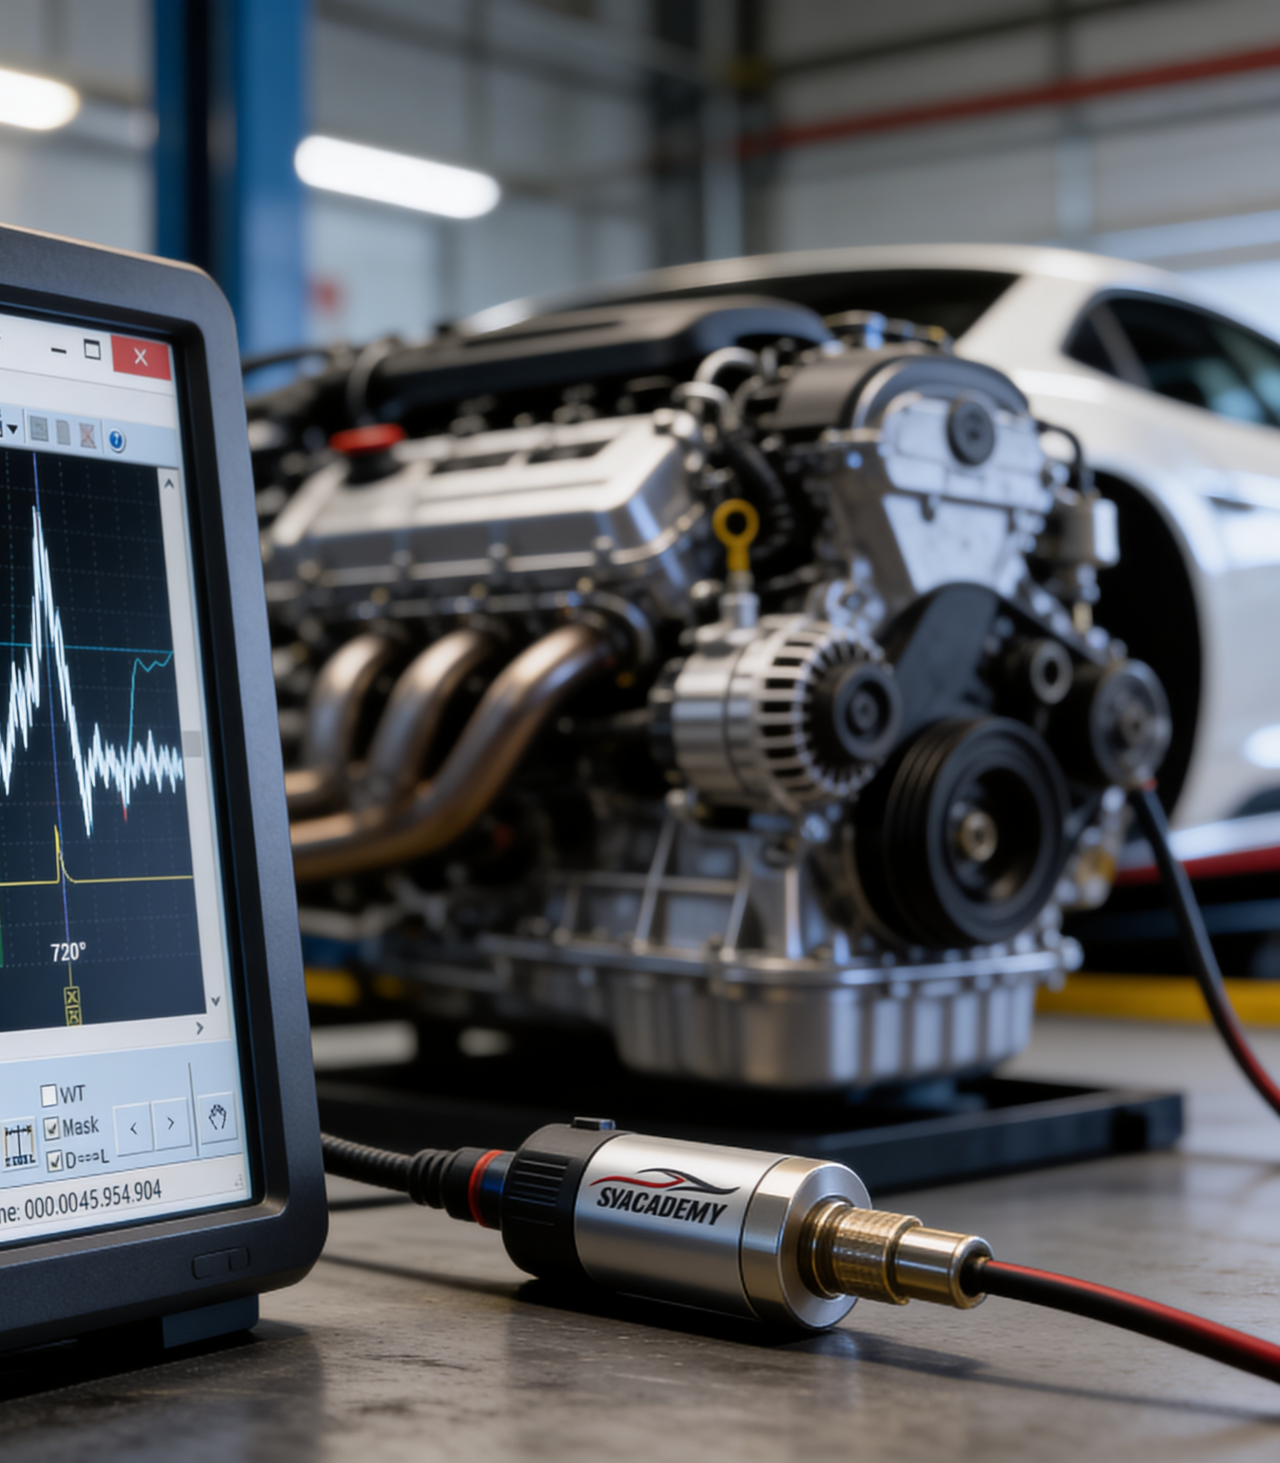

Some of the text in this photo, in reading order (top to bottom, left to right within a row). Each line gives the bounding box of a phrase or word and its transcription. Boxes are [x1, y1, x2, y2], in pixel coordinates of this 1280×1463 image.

[50, 941, 87, 963] 720°
[59, 1084, 86, 1104] WT
[62, 1115, 100, 1138] Mask
[597, 1187, 728, 1226] SYACADEMY
